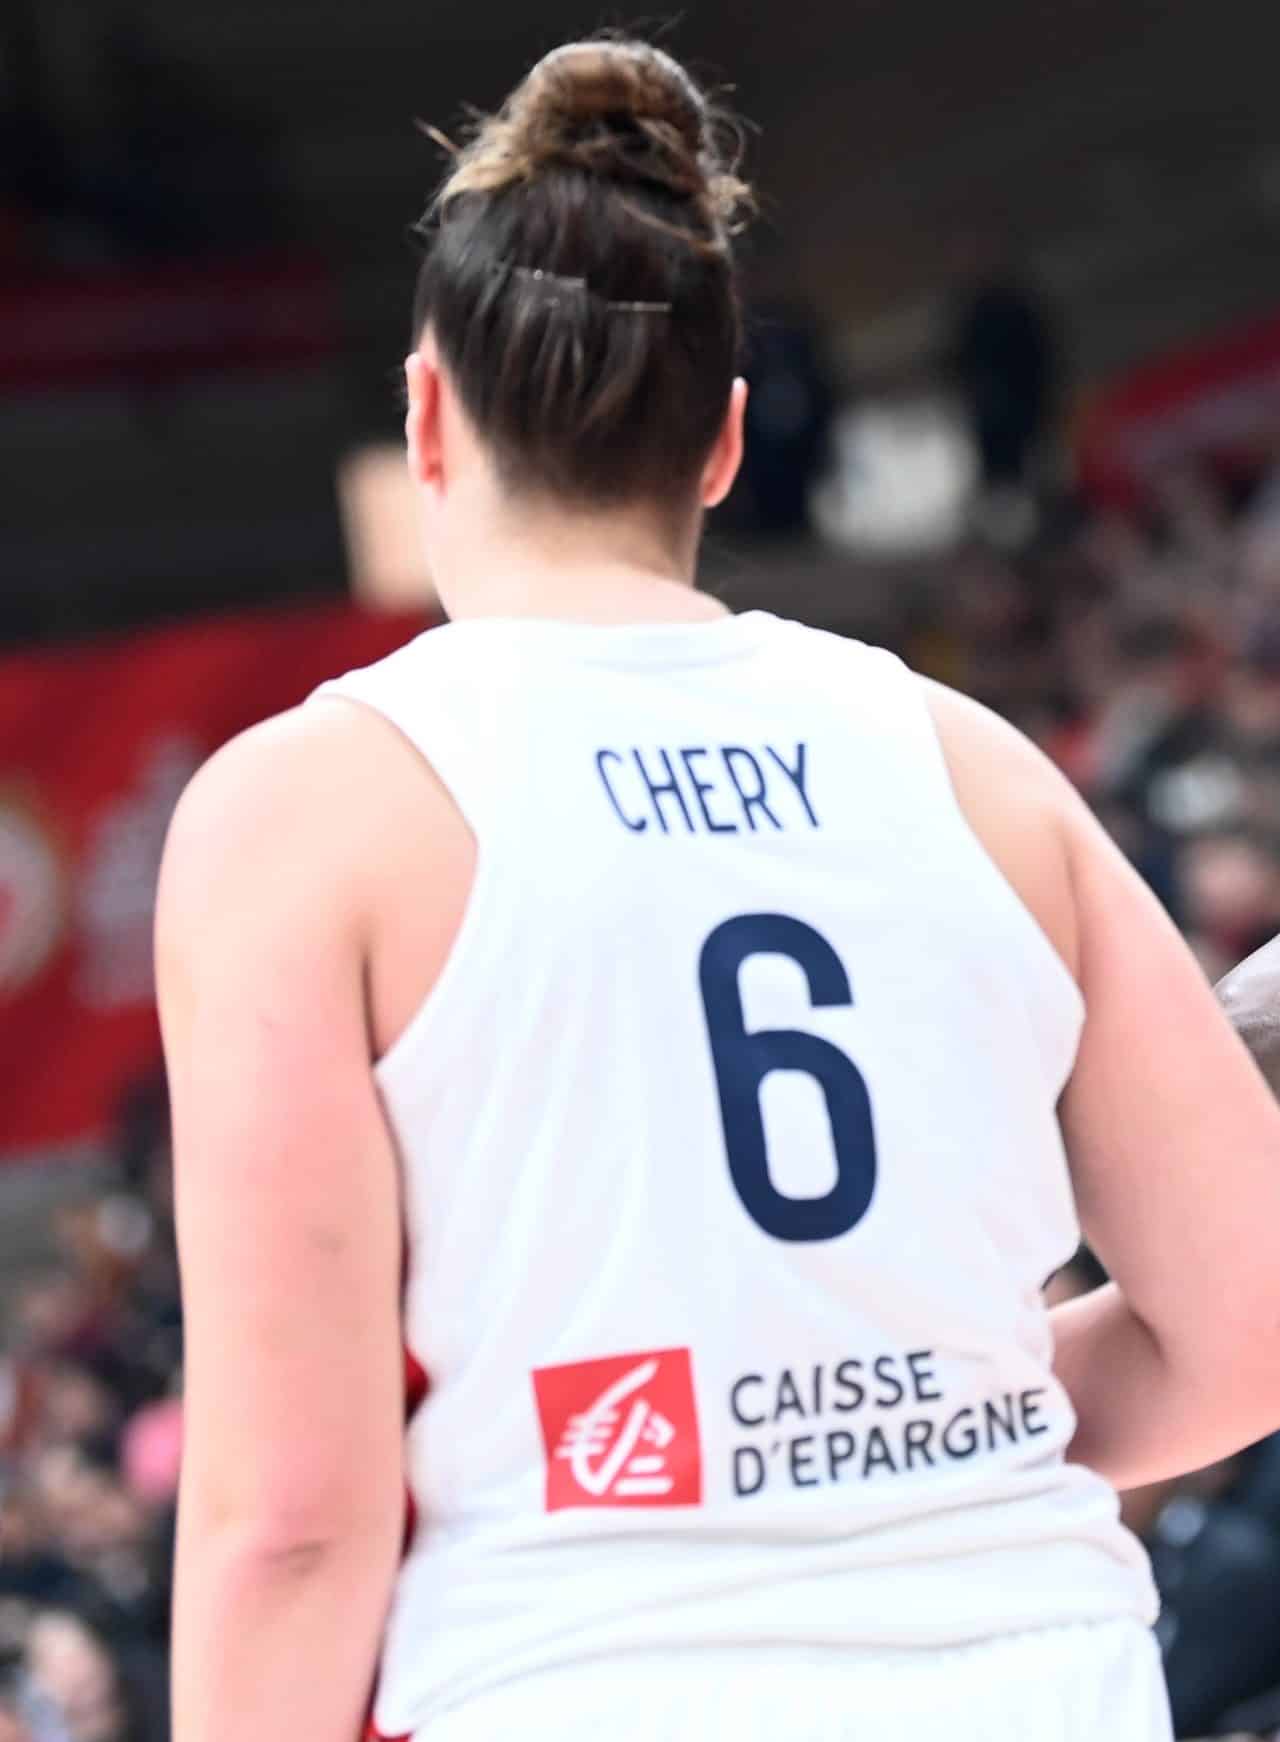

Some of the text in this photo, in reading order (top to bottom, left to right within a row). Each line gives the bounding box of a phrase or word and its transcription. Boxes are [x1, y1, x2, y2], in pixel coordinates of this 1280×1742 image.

[595, 743, 818, 834] CHERY
[698, 912, 877, 1243] 6
[729, 1349, 941, 1430] CAISSE
[731, 1388, 1049, 1499] D'EPARGNE
